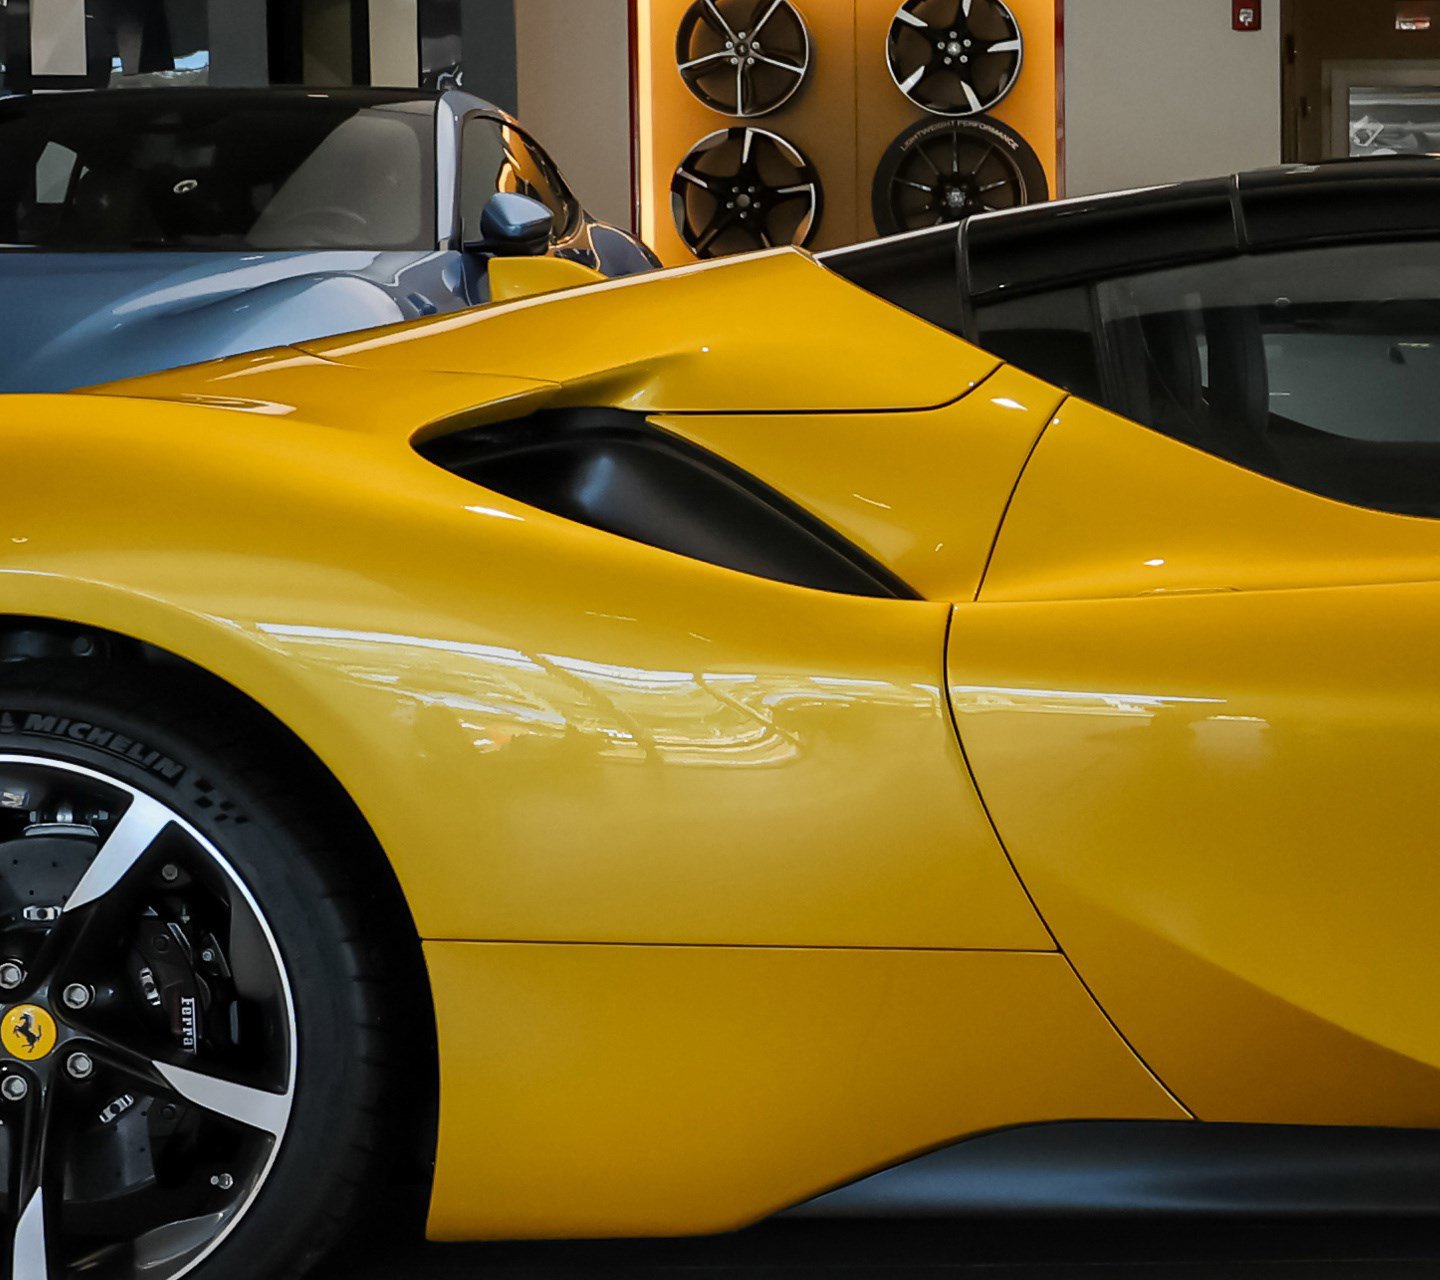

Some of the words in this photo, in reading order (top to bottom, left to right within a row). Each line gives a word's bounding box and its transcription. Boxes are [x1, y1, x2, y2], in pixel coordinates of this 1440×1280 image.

[900, 120, 955, 152] LIGHTWEIGHT
[957, 120, 1020, 151] PERFORMANCE
[23, 713, 185, 780] MICHELIN
